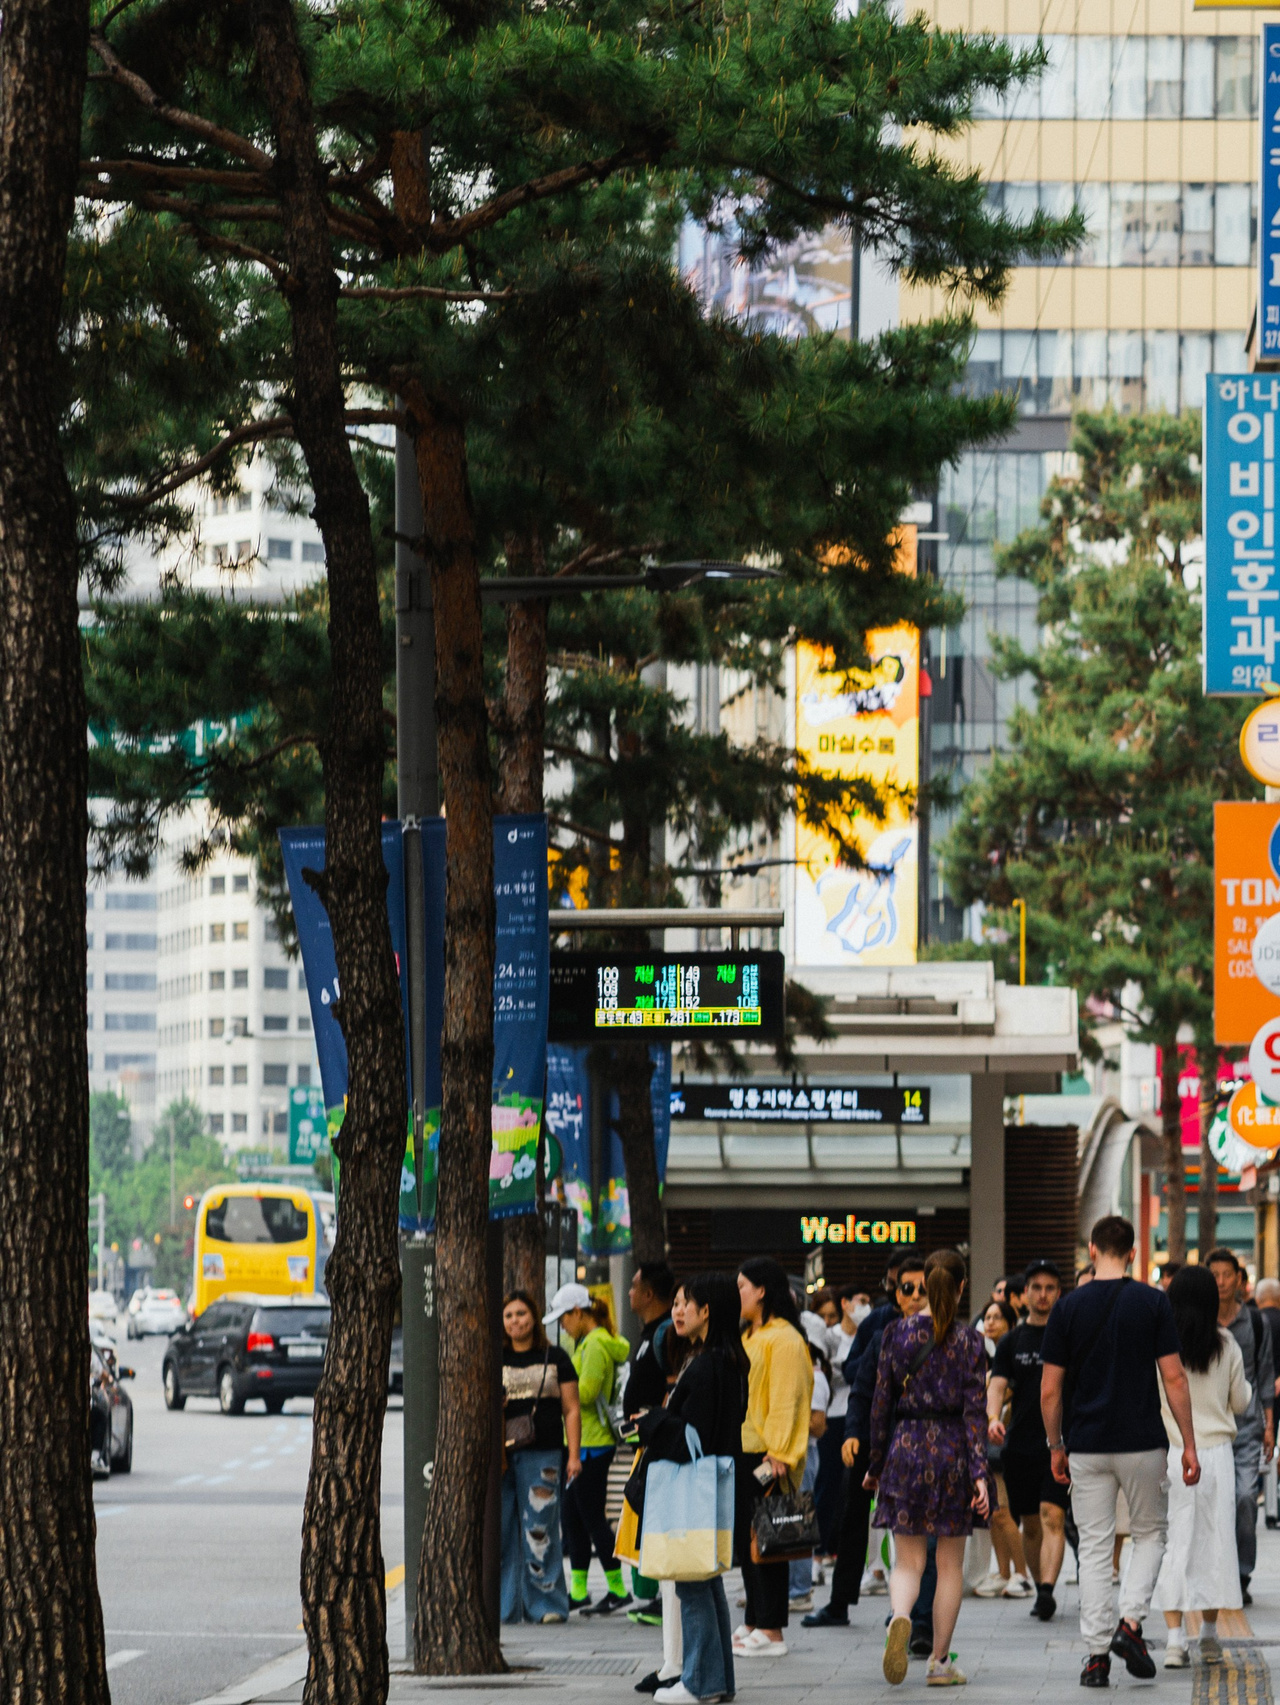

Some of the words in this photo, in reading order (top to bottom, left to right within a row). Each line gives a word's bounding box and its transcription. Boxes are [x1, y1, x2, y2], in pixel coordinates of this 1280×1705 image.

[1231, 664, 1273, 688] 의원
[904, 1090, 922, 1108] 14
[800, 1214, 917, 1243] Welcom
